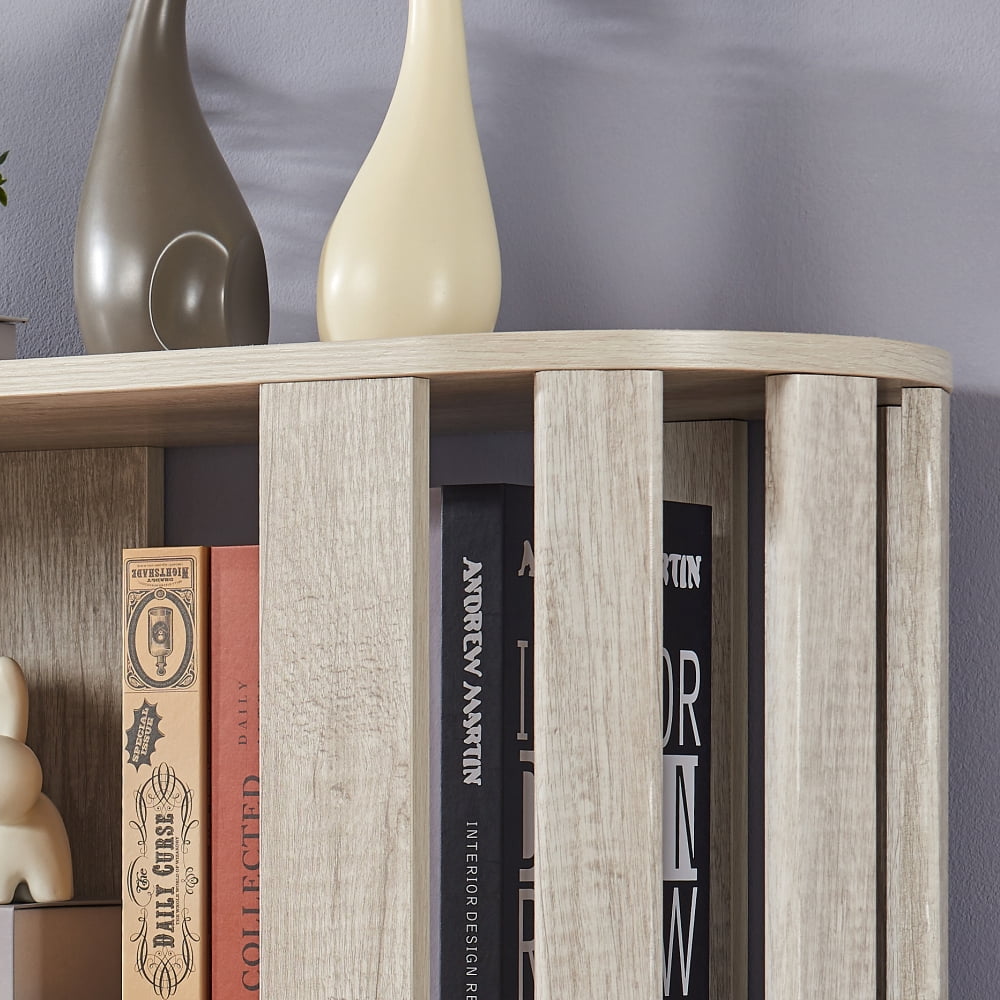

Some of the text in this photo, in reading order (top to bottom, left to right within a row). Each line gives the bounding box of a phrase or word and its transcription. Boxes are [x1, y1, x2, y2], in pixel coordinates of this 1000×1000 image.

[131, 566, 189, 579] NIGHTSHADE
[463, 557, 483, 786] ANDREW MARTIN
[132, 707, 149, 762] SPECIAL
[140, 716, 154, 756] ISSUE
[238, 682, 248, 745] DAILY
[152, 813, 175, 948] DAILY CURSE
[242, 775, 260, 992] COLLECTED
[466, 822, 478, 905] INTERIOR
[466, 912, 478, 976] DESIGN
